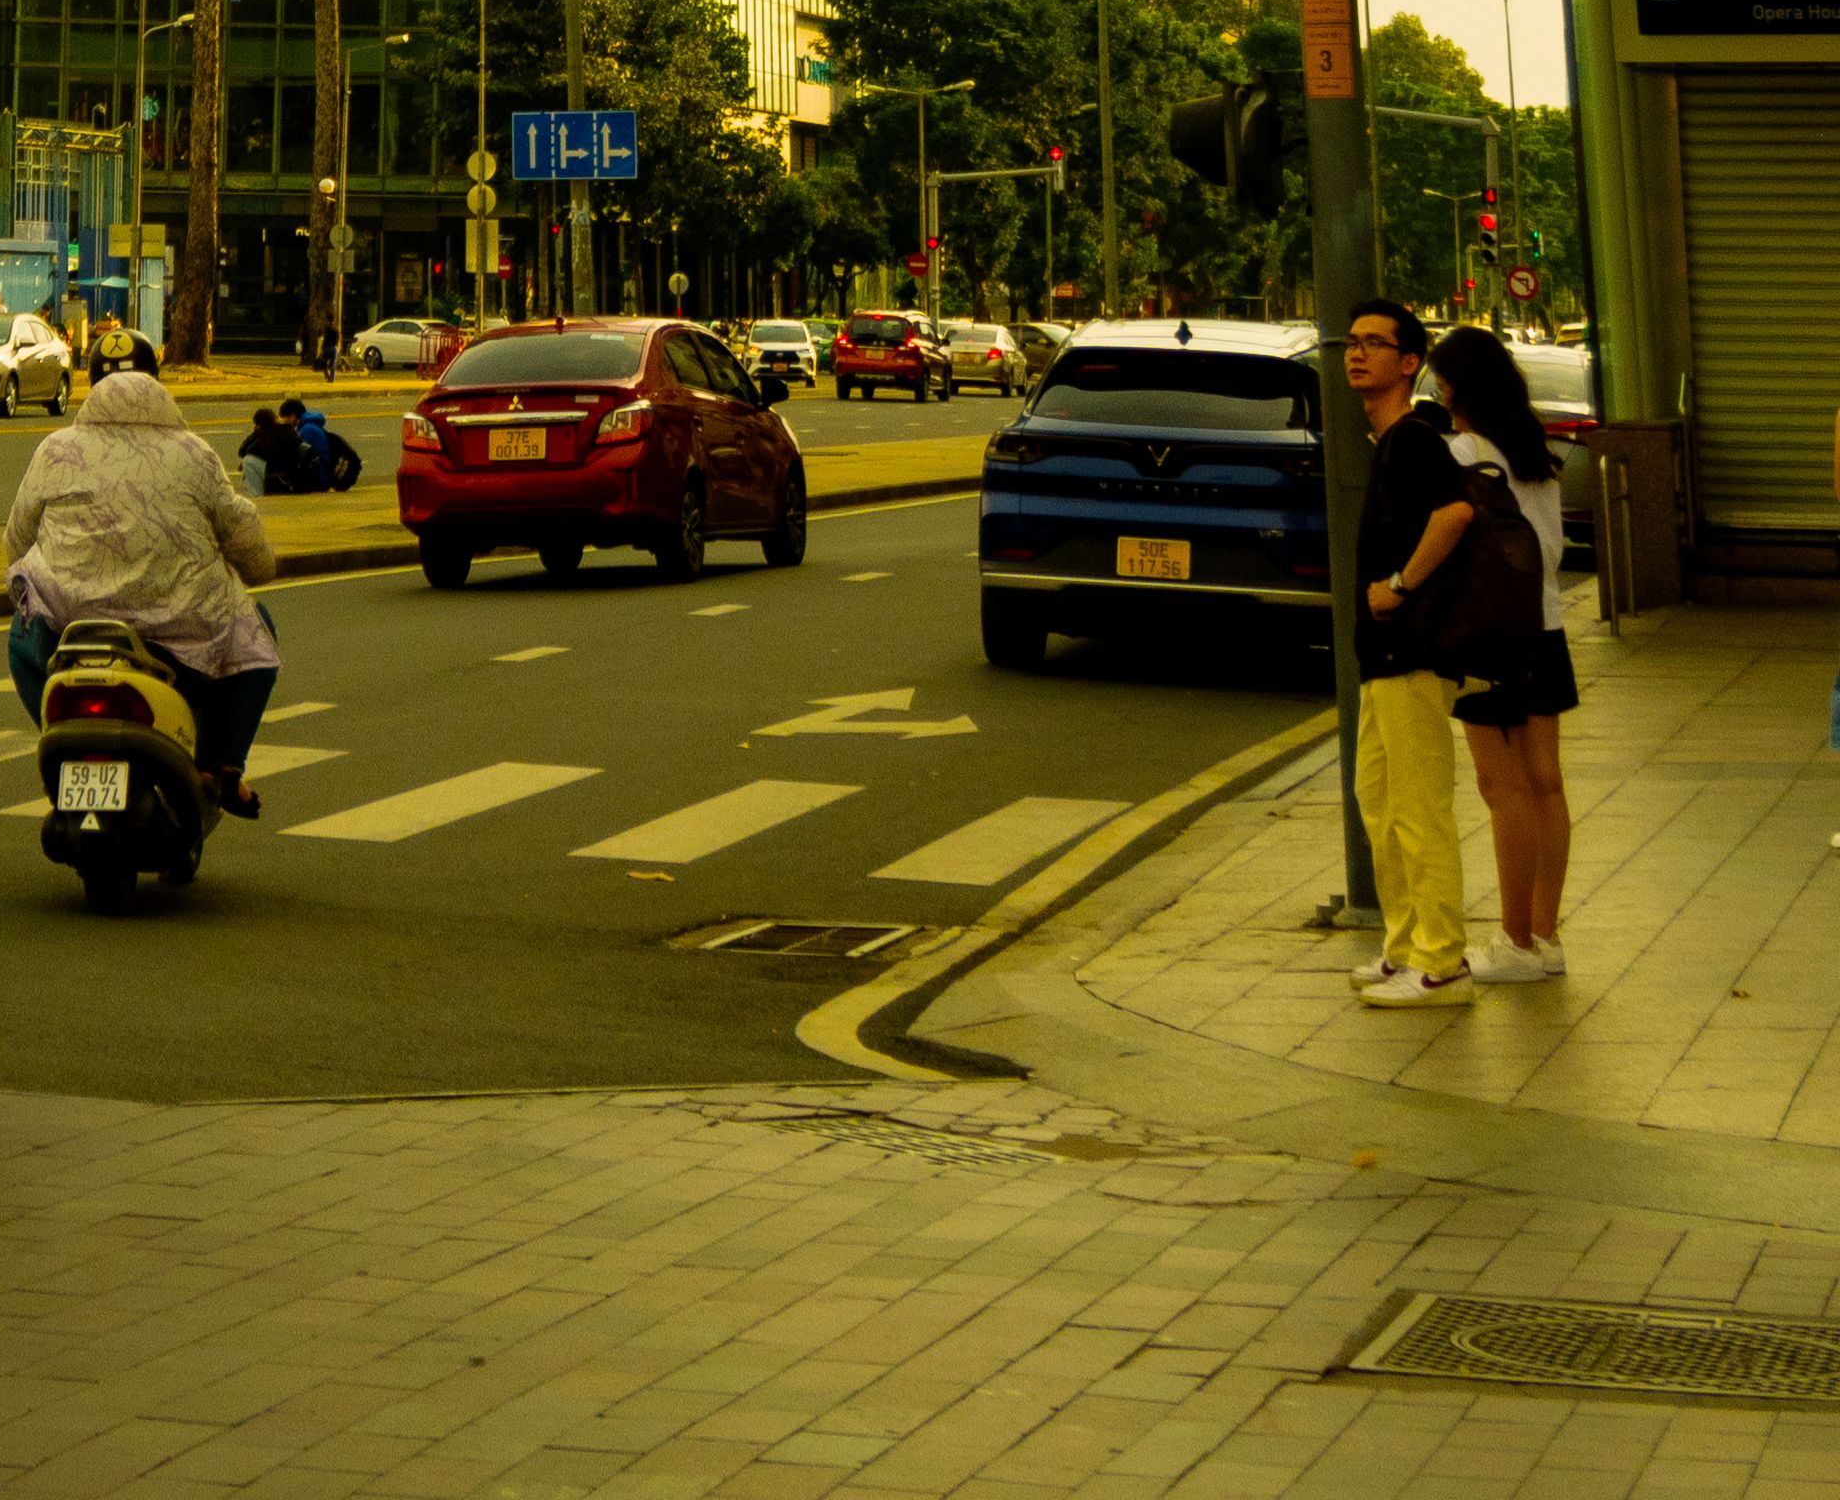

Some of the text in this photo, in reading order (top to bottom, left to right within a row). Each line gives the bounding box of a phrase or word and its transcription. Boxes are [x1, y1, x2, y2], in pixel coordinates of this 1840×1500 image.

[1753, 5, 1803, 24] Opera
[1319, 50, 1333, 73] 3
[506, 431, 530, 444] 37E
[496, 445, 539, 457] 001.39
[71, 765, 119, 786] 59-U2
[65, 787, 121, 808] 570.74
